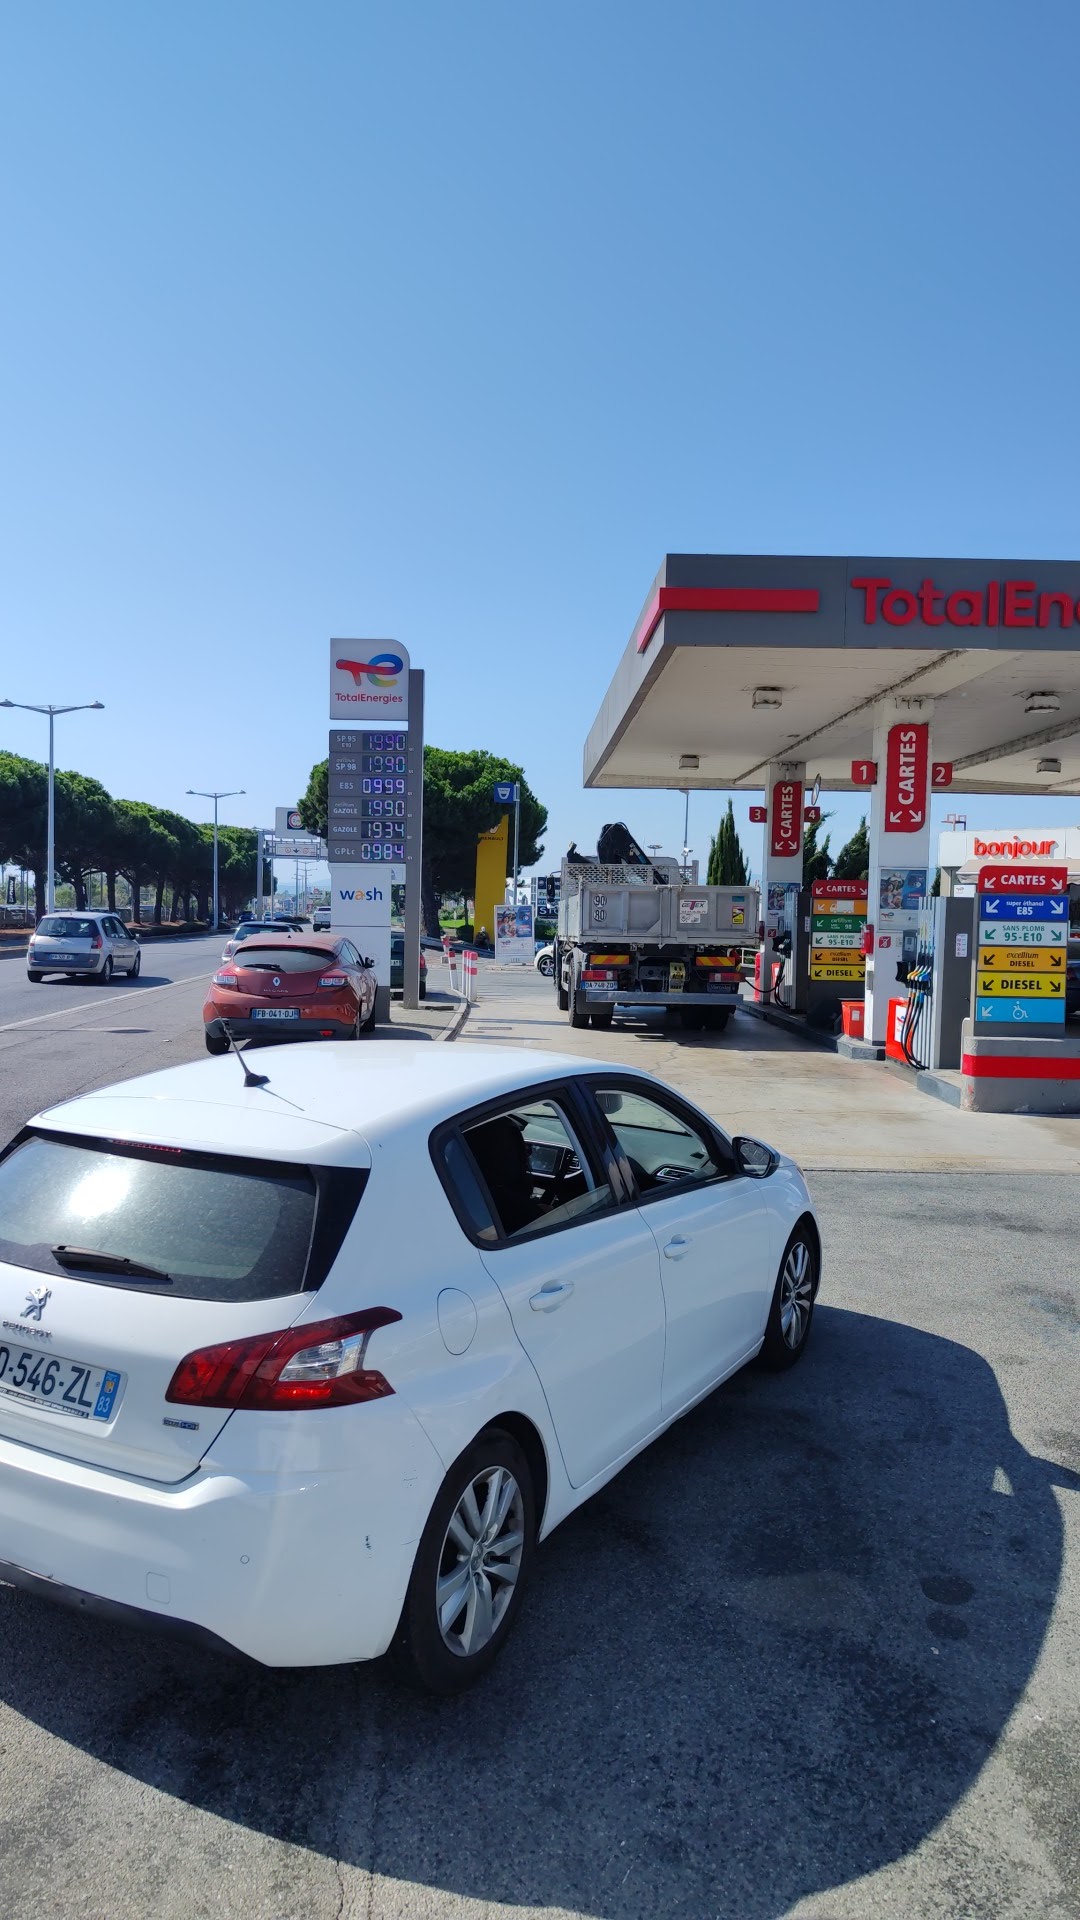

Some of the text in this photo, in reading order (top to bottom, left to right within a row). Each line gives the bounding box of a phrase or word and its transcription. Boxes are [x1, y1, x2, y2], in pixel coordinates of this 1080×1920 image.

[335, 693, 403, 705] TotalEnergies
[347, 735, 357, 743] 95
[335, 763, 357, 771] SP 98
[897, 730, 917, 805] CARTES
[859, 765, 867, 781] 1
[935, 766, 946, 783] 2
[339, 782, 354, 790] E85
[753, 809, 761, 820] 3
[780, 785, 794, 838] CARTES
[808, 809, 816, 820] 4
[334, 847, 356, 855] GPLc
[361, 843, 404, 860] 0.984
[974, 836, 1056, 859] bonjour
[1000, 874, 1046, 886] CARTES
[340, 887, 383, 900] wash
[826, 885, 857, 893] CARTES
[1016, 906, 1033, 916] E85
[1004, 932, 1042, 942] 95-E10
[1006, 951, 1039, 959] excellium
[1009, 960, 1035, 968] DIESEL
[826, 969, 854, 977] DIESEL
[1001, 979, 1042, 990] DIESEL
[2, 1320, 52, 1338] PEUGEOT
[97, 1396, 111, 1413] 83
